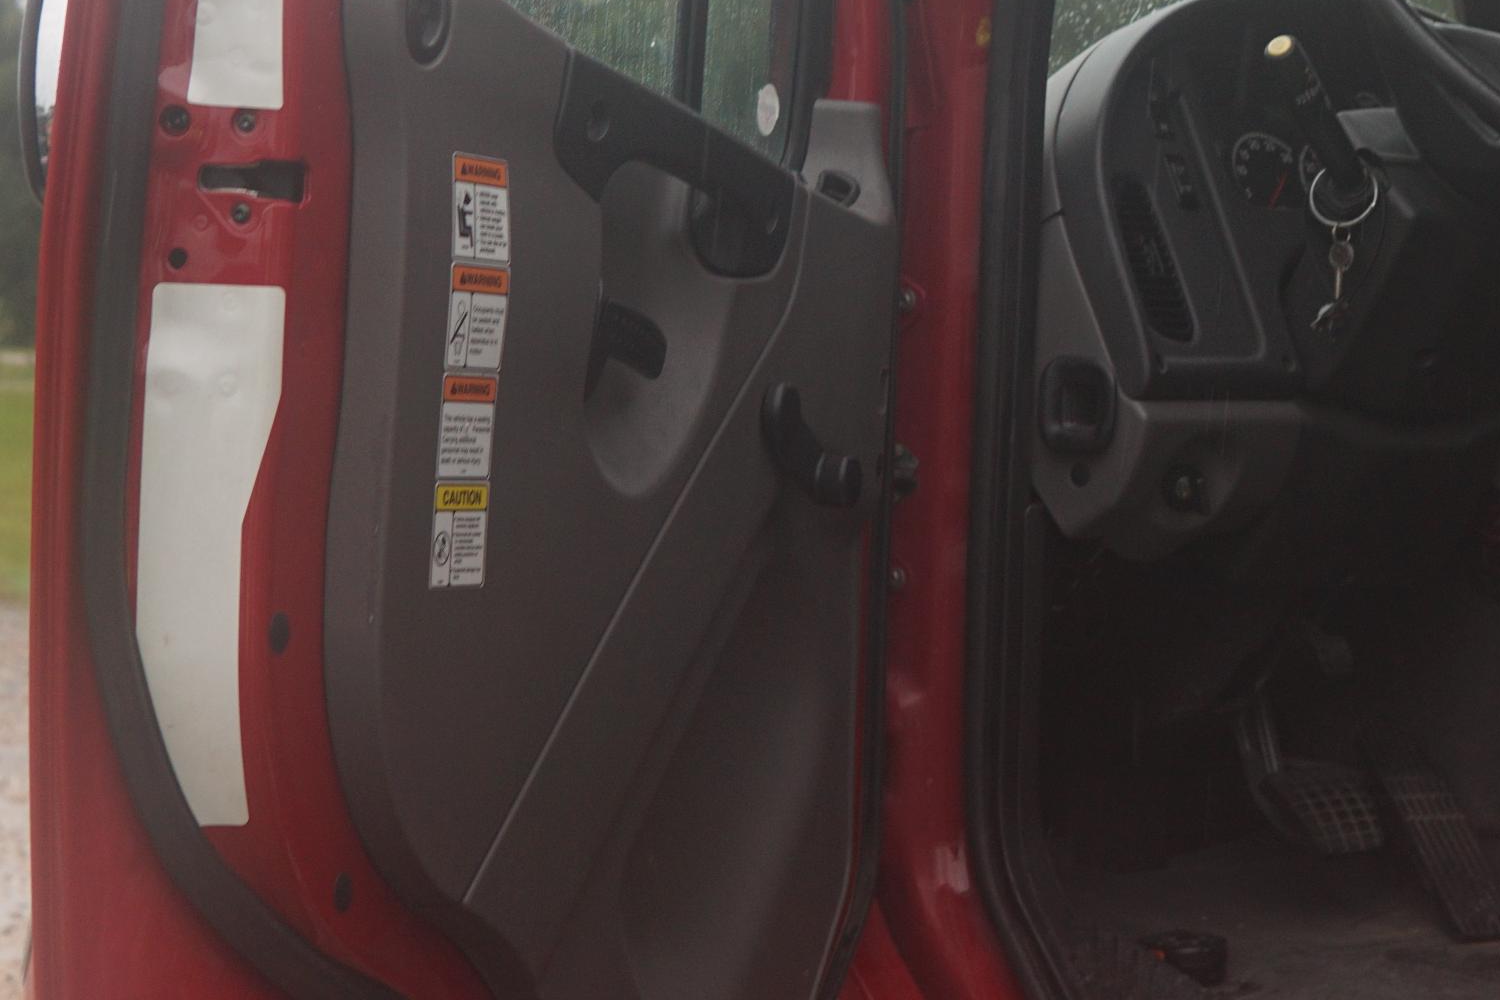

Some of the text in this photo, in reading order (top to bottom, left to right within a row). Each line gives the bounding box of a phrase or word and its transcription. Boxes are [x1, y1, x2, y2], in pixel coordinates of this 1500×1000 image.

[467, 164, 501, 181] WARNING
[465, 273, 502, 289] WARNING
[457, 383, 490, 396] WARNING
[443, 489, 482, 506] CAUTION
